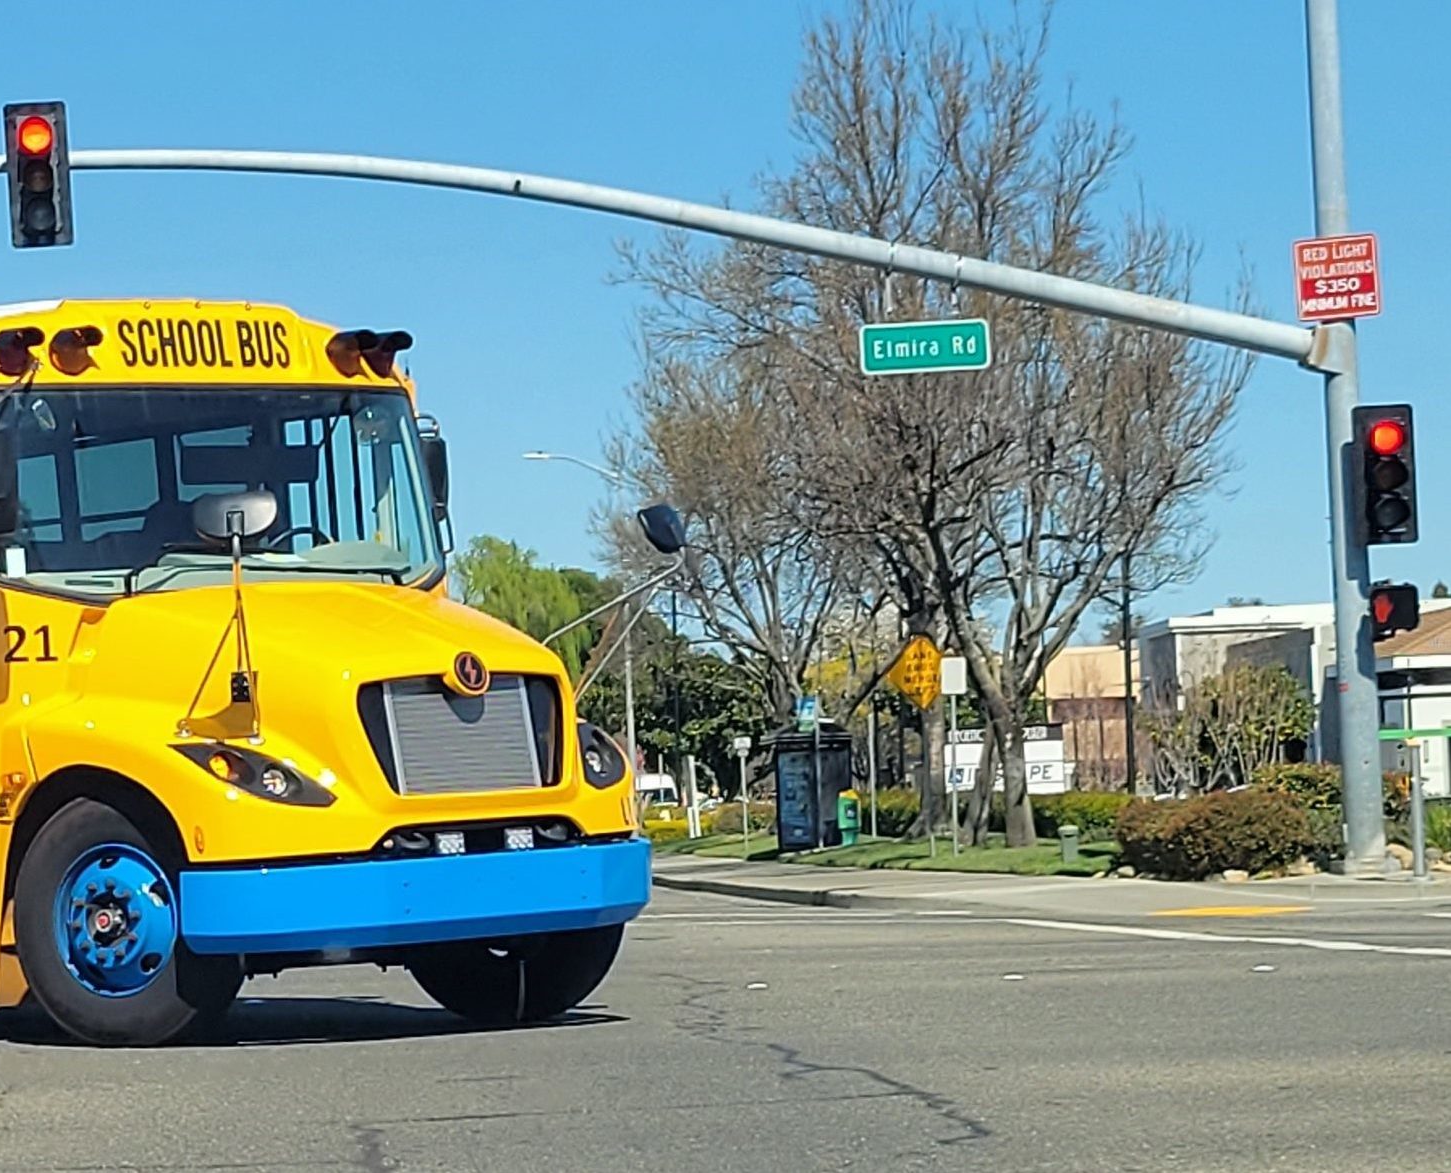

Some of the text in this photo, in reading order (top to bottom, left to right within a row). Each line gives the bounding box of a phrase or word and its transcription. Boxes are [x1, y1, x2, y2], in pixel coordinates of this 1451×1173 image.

[1303, 242, 1368, 262] RED LIGHT
[1300, 260, 1373, 279] VIOLATIONS
[1314, 277, 1360, 294] $350
[1302, 292, 1376, 311] MINIMUM FINE
[117, 318, 290, 369] SCHOOL BUS
[873, 335, 977, 359] Elmira Rd
[4, 625, 58, 662] 21
